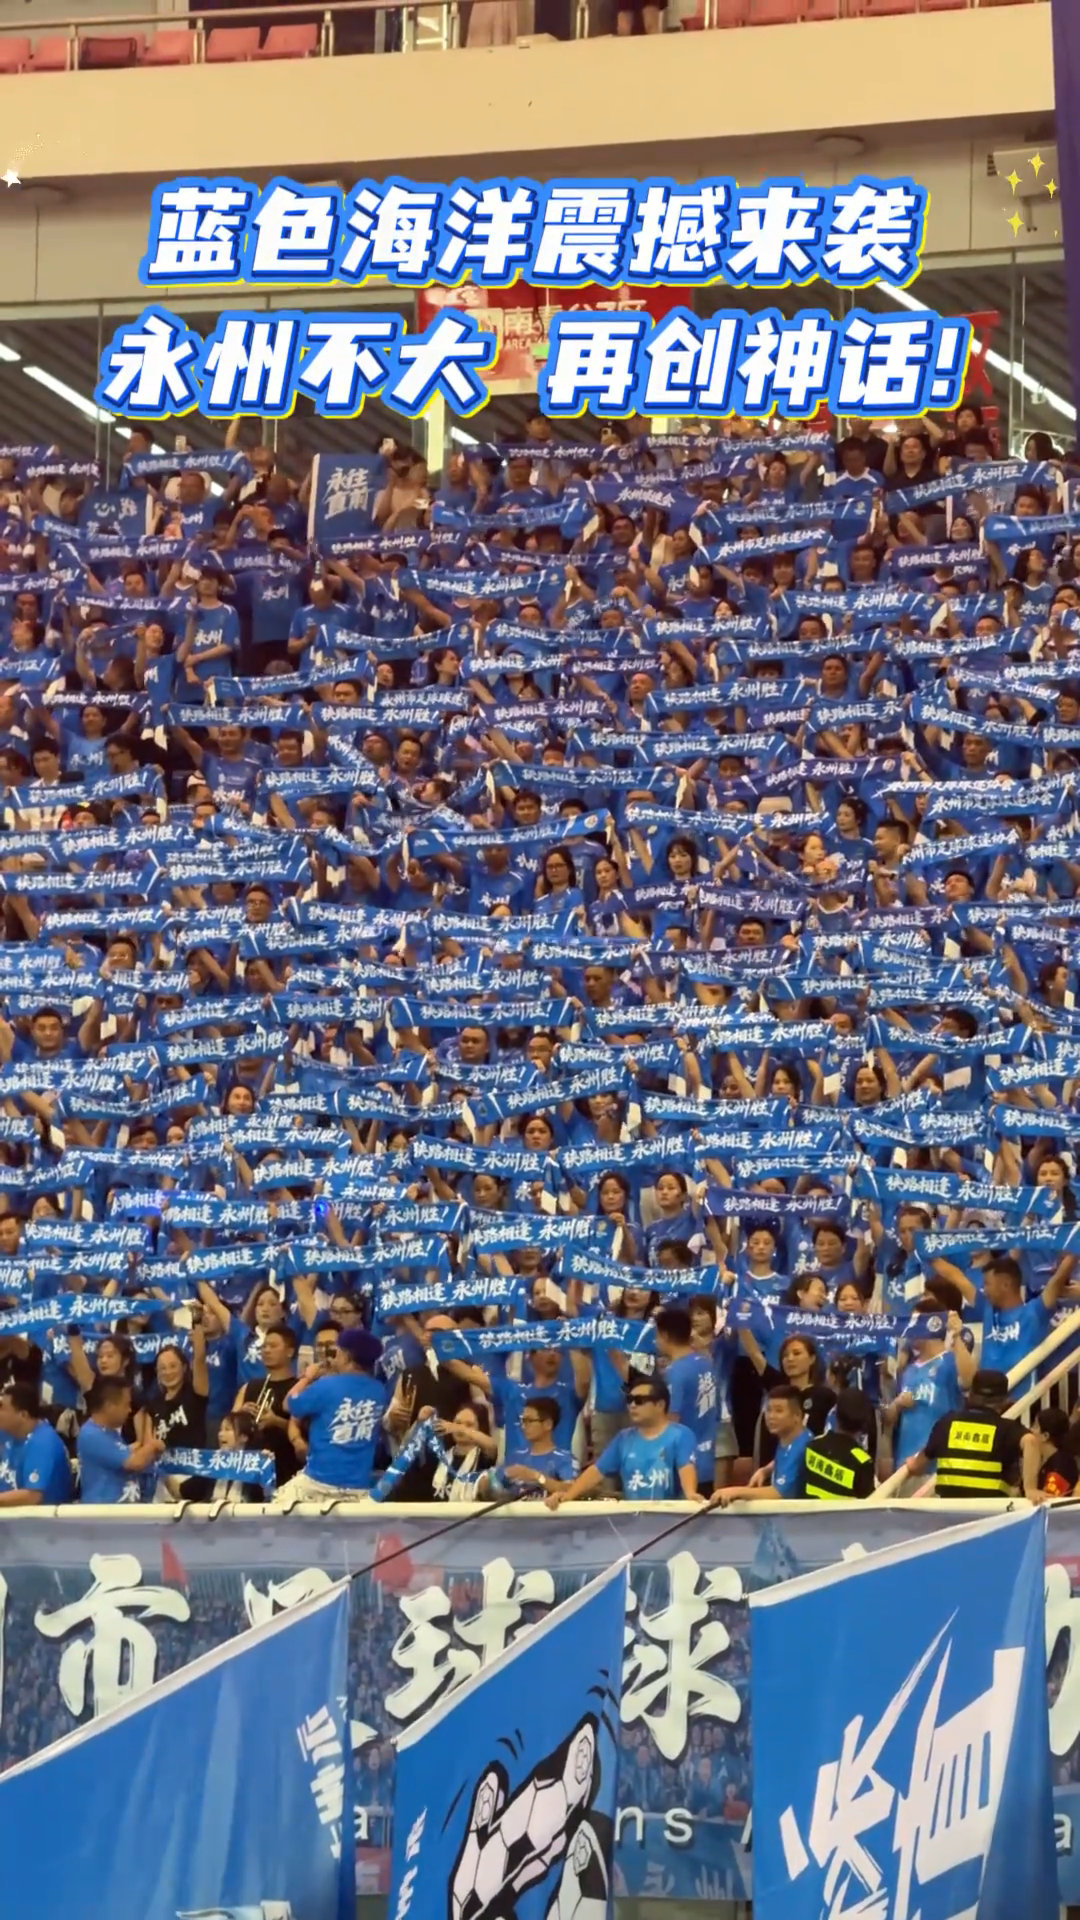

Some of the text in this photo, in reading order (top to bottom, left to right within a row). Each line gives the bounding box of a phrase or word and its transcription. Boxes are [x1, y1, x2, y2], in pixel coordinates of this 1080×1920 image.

[946, 549, 985, 563] 永州胜
[715, 1099, 779, 1118] 永州胜!
[759, 1131, 822, 1152] 永州胜!
[886, 1174, 1022, 1204] 狭路相逢 永州胜!
[385, 1202, 450, 1228] 永州胜!
[723, 1194, 843, 1213] 狭路相逢 永州胜!
[304, 1239, 435, 1267] 狭路相逢 永州胜!
[572, 1254, 637, 1284] 狭路相逢
[381, 1274, 516, 1310] 狭路相逢 永州胜!
[478, 1317, 630, 1349] 狭路相逢 永州胜!
[209, 1449, 272, 1473] 永州胜!
[628, 1470, 670, 1492] 永州
